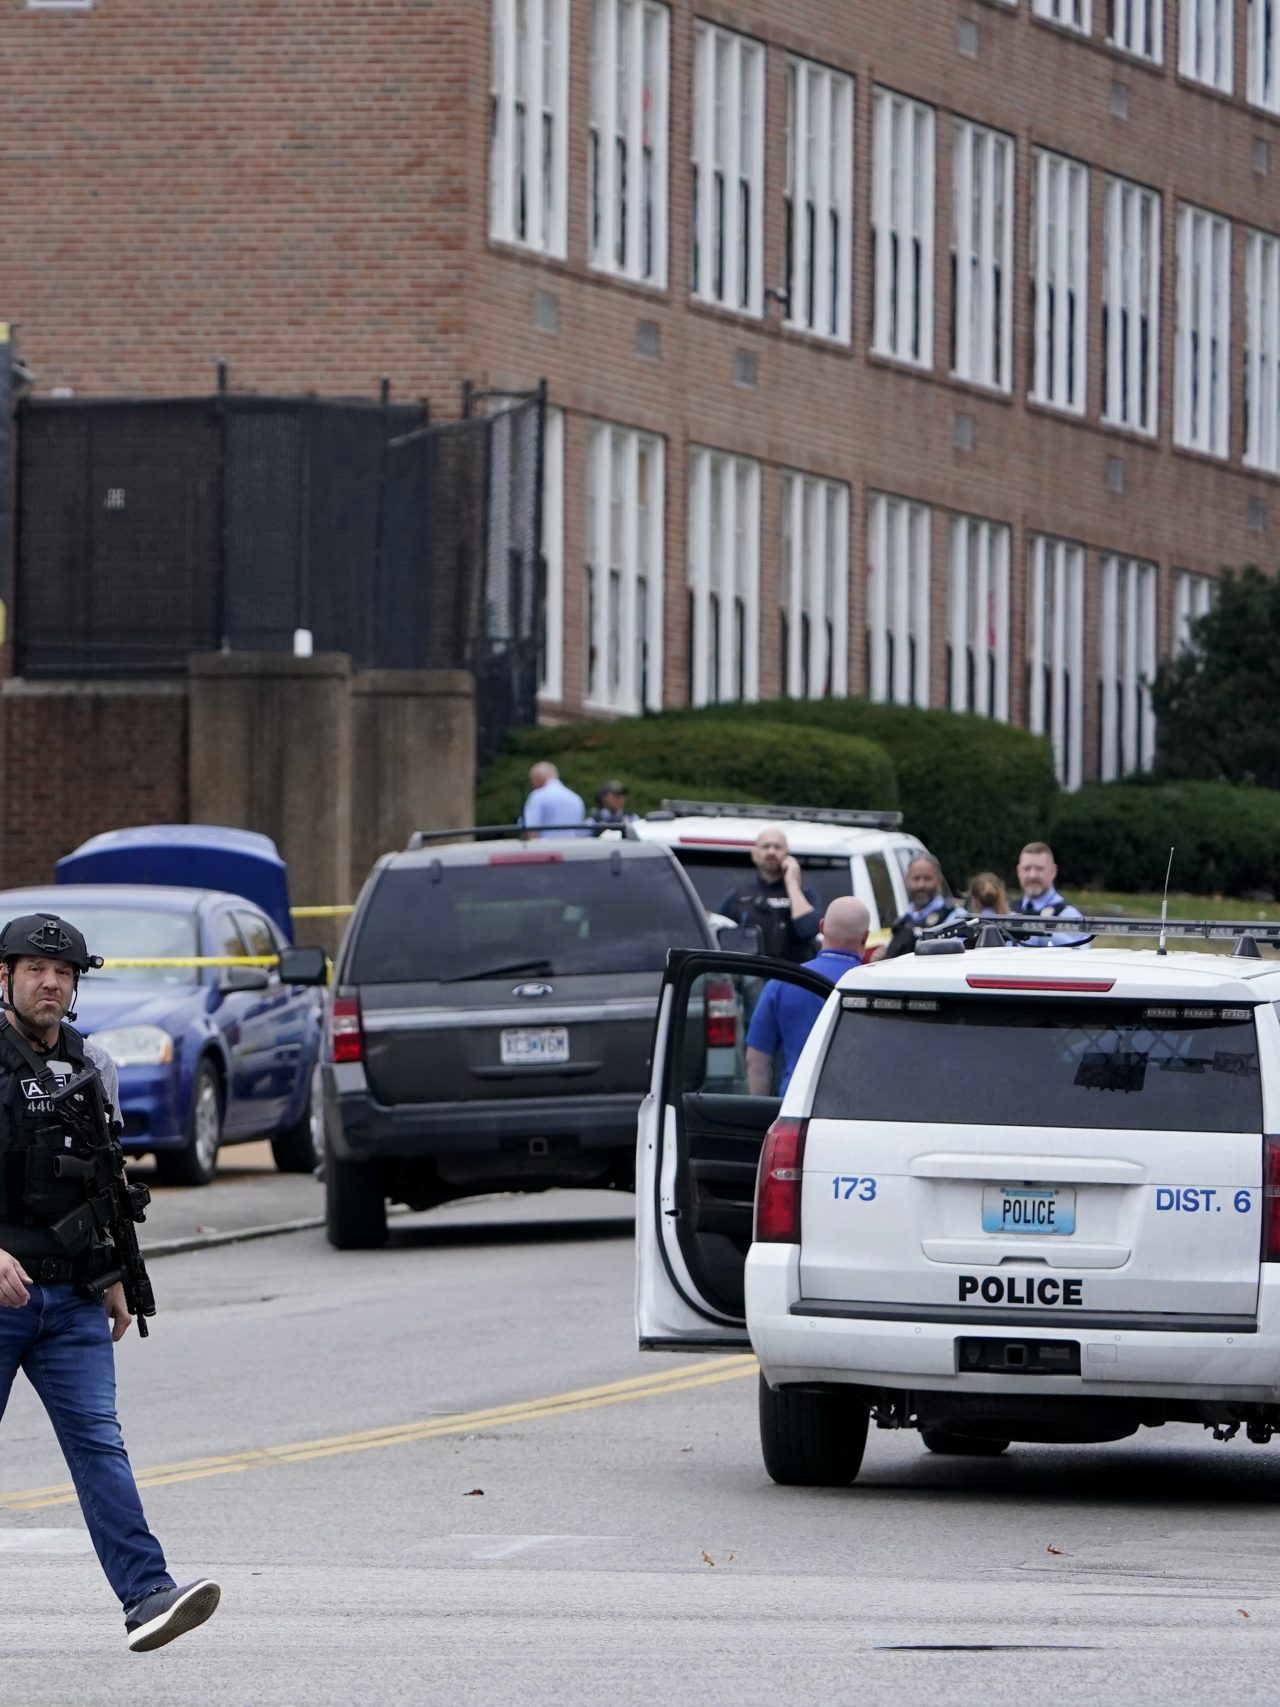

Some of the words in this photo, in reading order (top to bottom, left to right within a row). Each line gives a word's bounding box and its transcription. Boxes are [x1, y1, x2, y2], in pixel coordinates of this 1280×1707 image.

[832, 1176, 877, 1201] 173
[1156, 1188, 1221, 1212] DIST.
[1233, 1190, 1251, 1213] 6
[1002, 1199, 1056, 1224] POLICE
[959, 1275, 1084, 1306] POLICE
